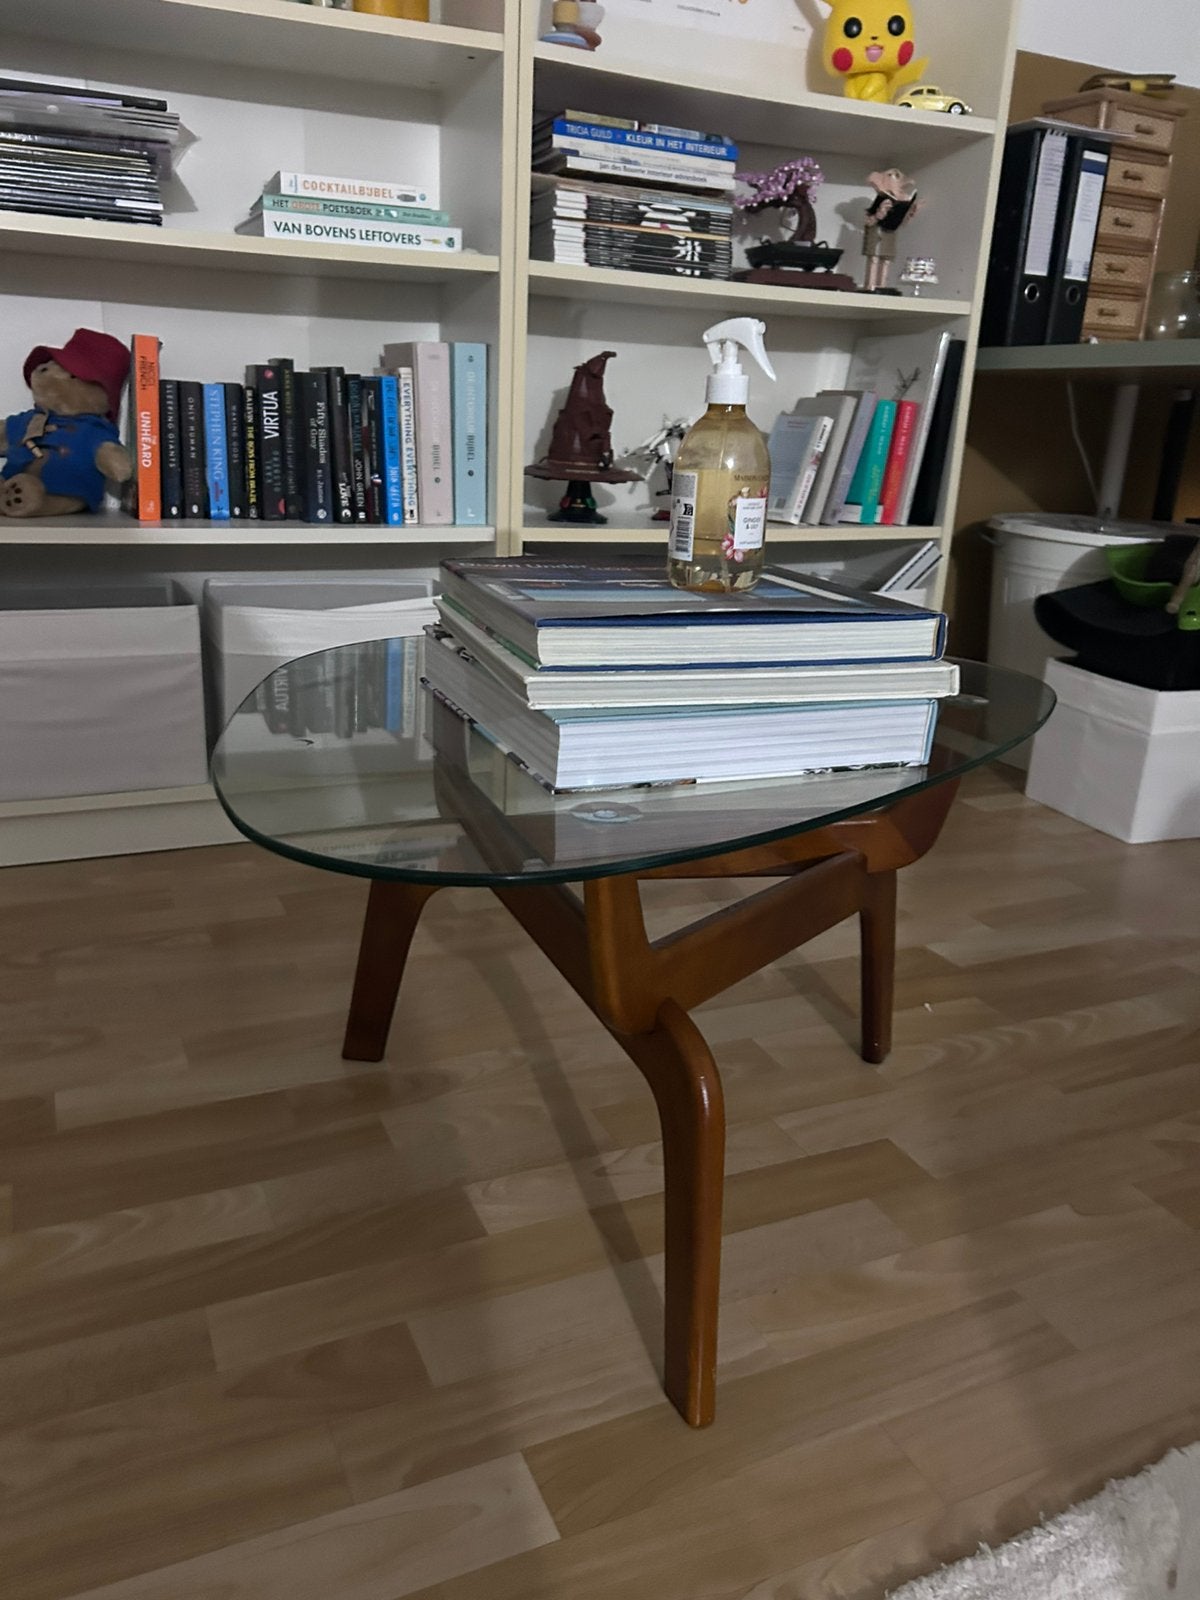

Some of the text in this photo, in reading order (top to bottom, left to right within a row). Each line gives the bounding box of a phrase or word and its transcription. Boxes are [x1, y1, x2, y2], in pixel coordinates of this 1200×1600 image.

[565, 123, 613, 139] TRICIA GUILD
[625, 133, 654, 146] KLEUR
[655, 138, 665, 148] IN
[667, 139, 683, 150] HET
[685, 142, 728, 156] INTERIEUR
[272, 199, 289, 209] HET
[322, 203, 373, 217] POETSBOEK
[273, 220, 422, 246] VAN BOVENS LEFTOVERS
[140, 355, 148, 391] FRENCH
[140, 411, 152, 468] UNHEARD
[166, 384, 176, 468] SLEEPING GIANTS
[187, 397, 197, 459] ONLY HUMAN
[209, 389, 223, 445] STEPHEN
[262, 391, 280, 440] VIRTUA
[309, 418, 318, 450] of Grey
[316, 401, 327, 464] Fifty Shades
[212, 448, 225, 480] KING
[403, 382, 415, 506] EVERYTHING EVERYTHING
[354, 459, 365, 507] JOHN GREEN
